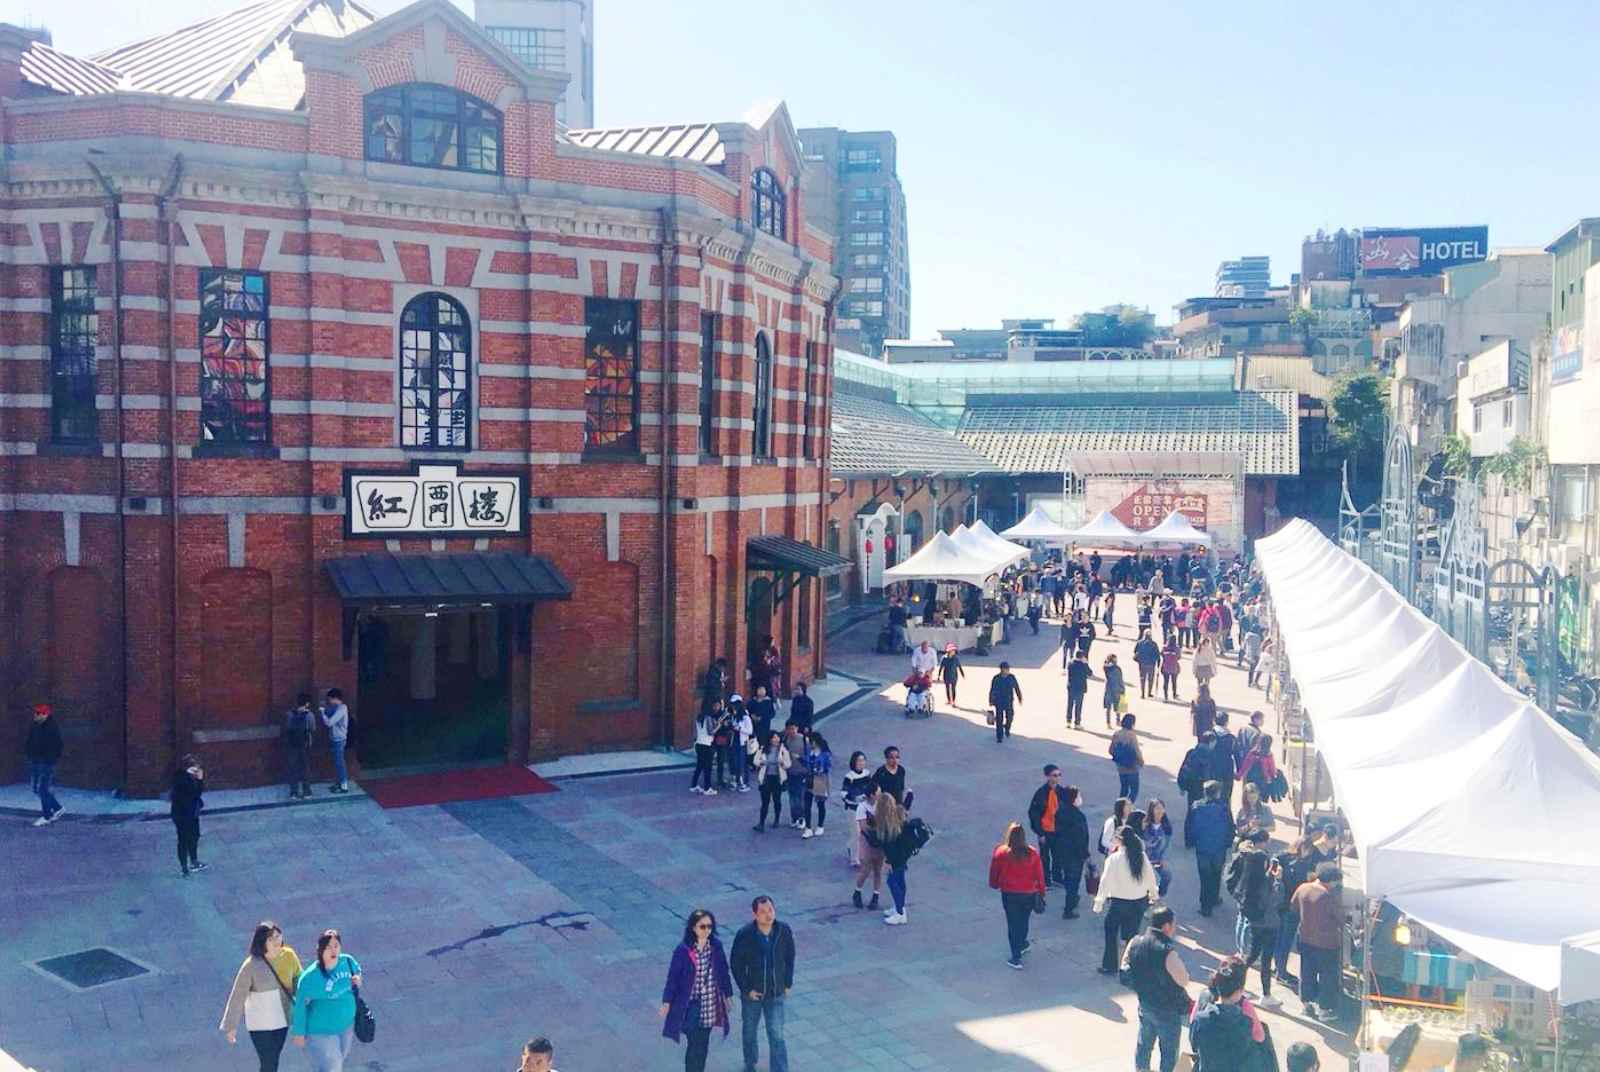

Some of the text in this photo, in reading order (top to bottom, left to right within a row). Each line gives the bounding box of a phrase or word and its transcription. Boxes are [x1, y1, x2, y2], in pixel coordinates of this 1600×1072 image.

[1422, 240, 1486, 260] HOTEL
[367, 488, 407, 521] 紅
[428, 485, 449, 524] 西門
